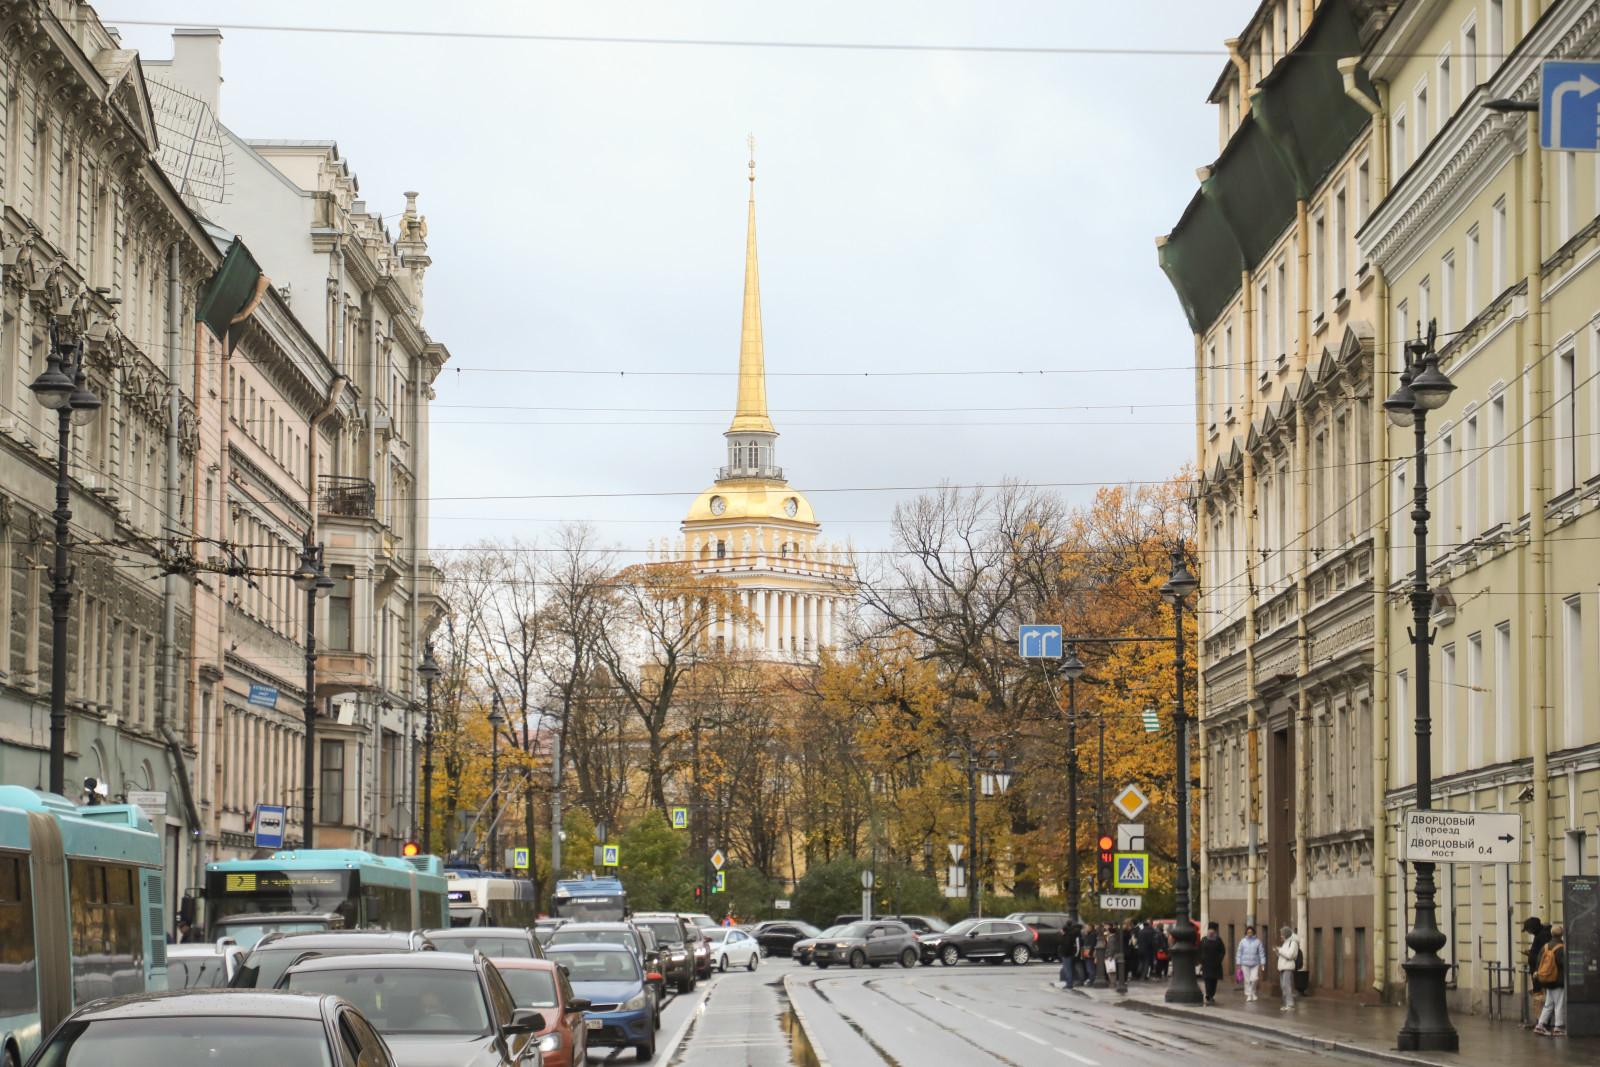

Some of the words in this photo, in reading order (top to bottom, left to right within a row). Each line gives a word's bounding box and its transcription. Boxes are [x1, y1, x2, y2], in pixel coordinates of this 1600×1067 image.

[1411, 815, 1475, 826] ДВОРЦОВЫЙ
[1425, 827, 1460, 835] проезд
[1410, 839, 1475, 849] ДВОРЦОВЫЙ
[1106, 897, 1136, 907] СТОП
